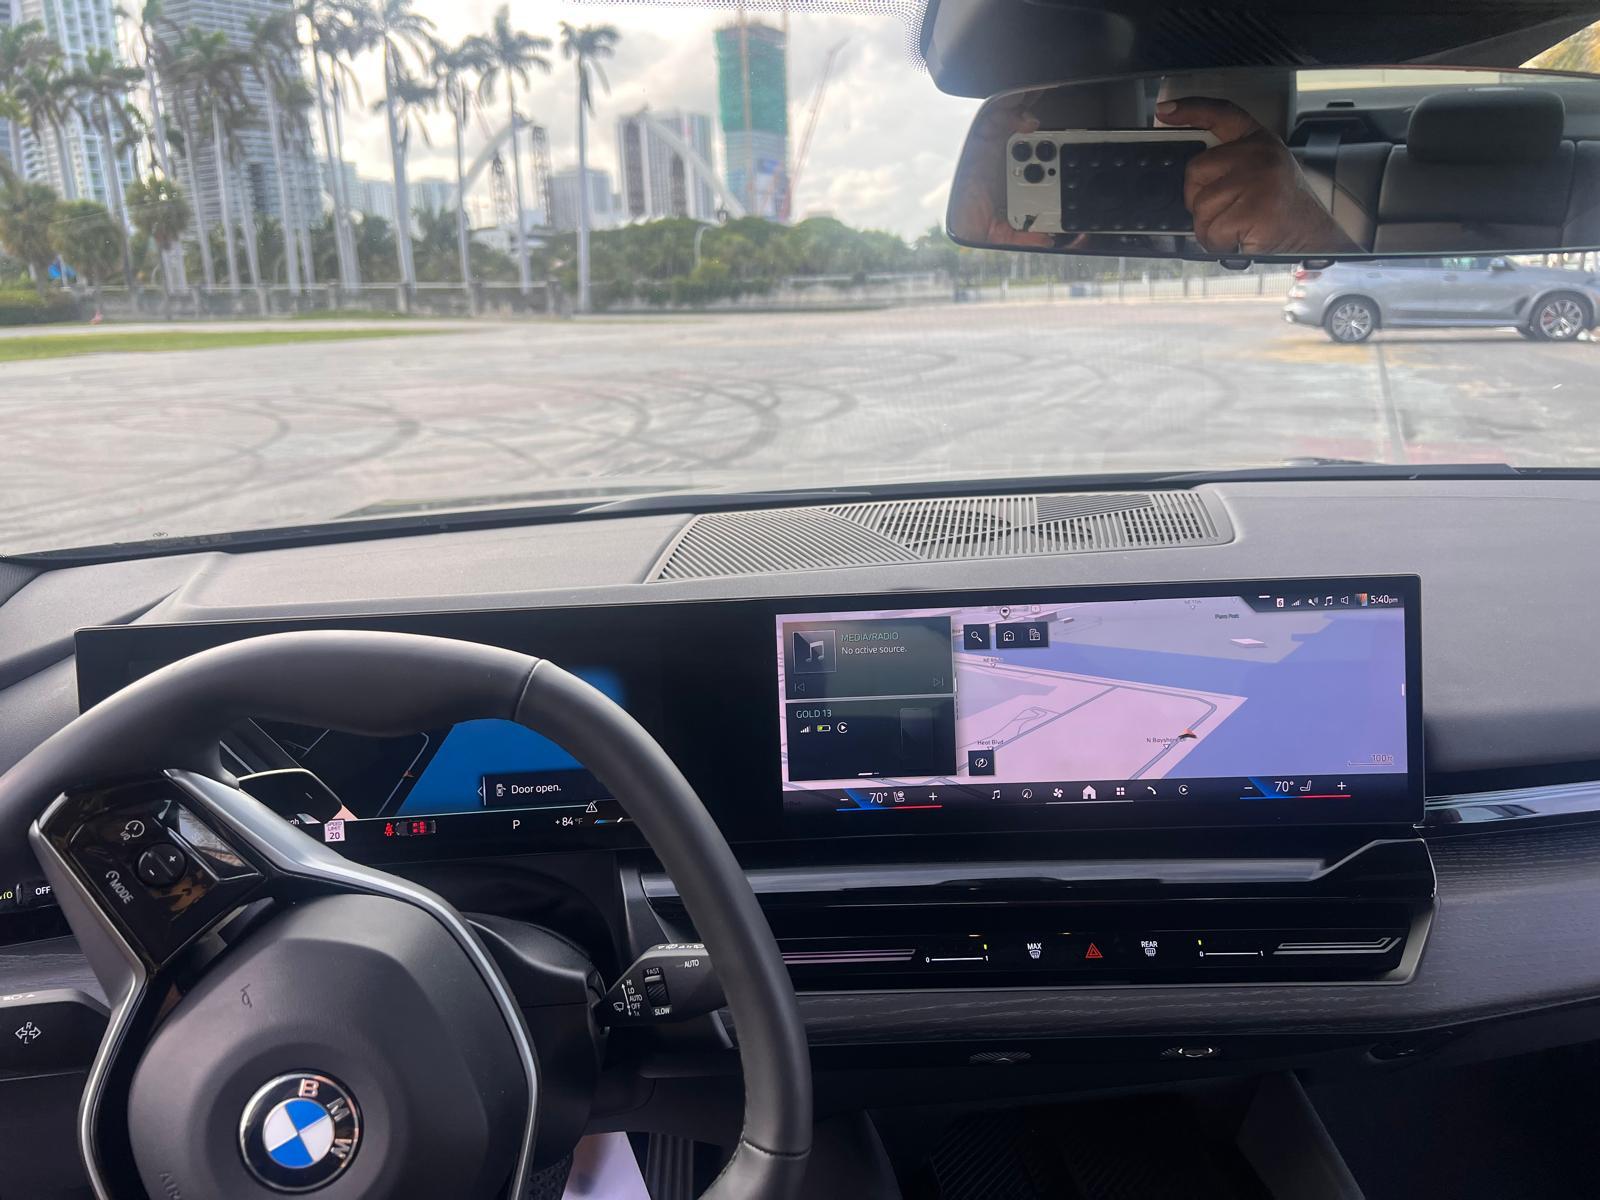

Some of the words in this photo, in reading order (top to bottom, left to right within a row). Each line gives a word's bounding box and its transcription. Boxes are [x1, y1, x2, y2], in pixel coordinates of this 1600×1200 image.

[841, 632, 899, 641] MEDIA/RADIO
[841, 647, 854, 655] No
[855, 646, 878, 654] active
[880, 646, 908, 654] source.
[796, 710, 821, 718] GOLD
[823, 709, 832, 717] 13
[511, 785, 534, 794] Door
[535, 784, 562, 794] open.
[1274, 780, 1295, 792] 70°
[869, 792, 888, 804] 70°
[512, 819, 521, 829] P
[329, 832, 340, 840] 20
[35, 886, 51, 896] OFF
[109, 881, 134, 904] MODE
[1026, 942, 1042, 950] MAX
[684, 959, 700, 968] AUTO
[646, 967, 660, 975] FAST
[629, 994, 643, 1002] AUTO
[654, 1007, 670, 1016] SLOW
